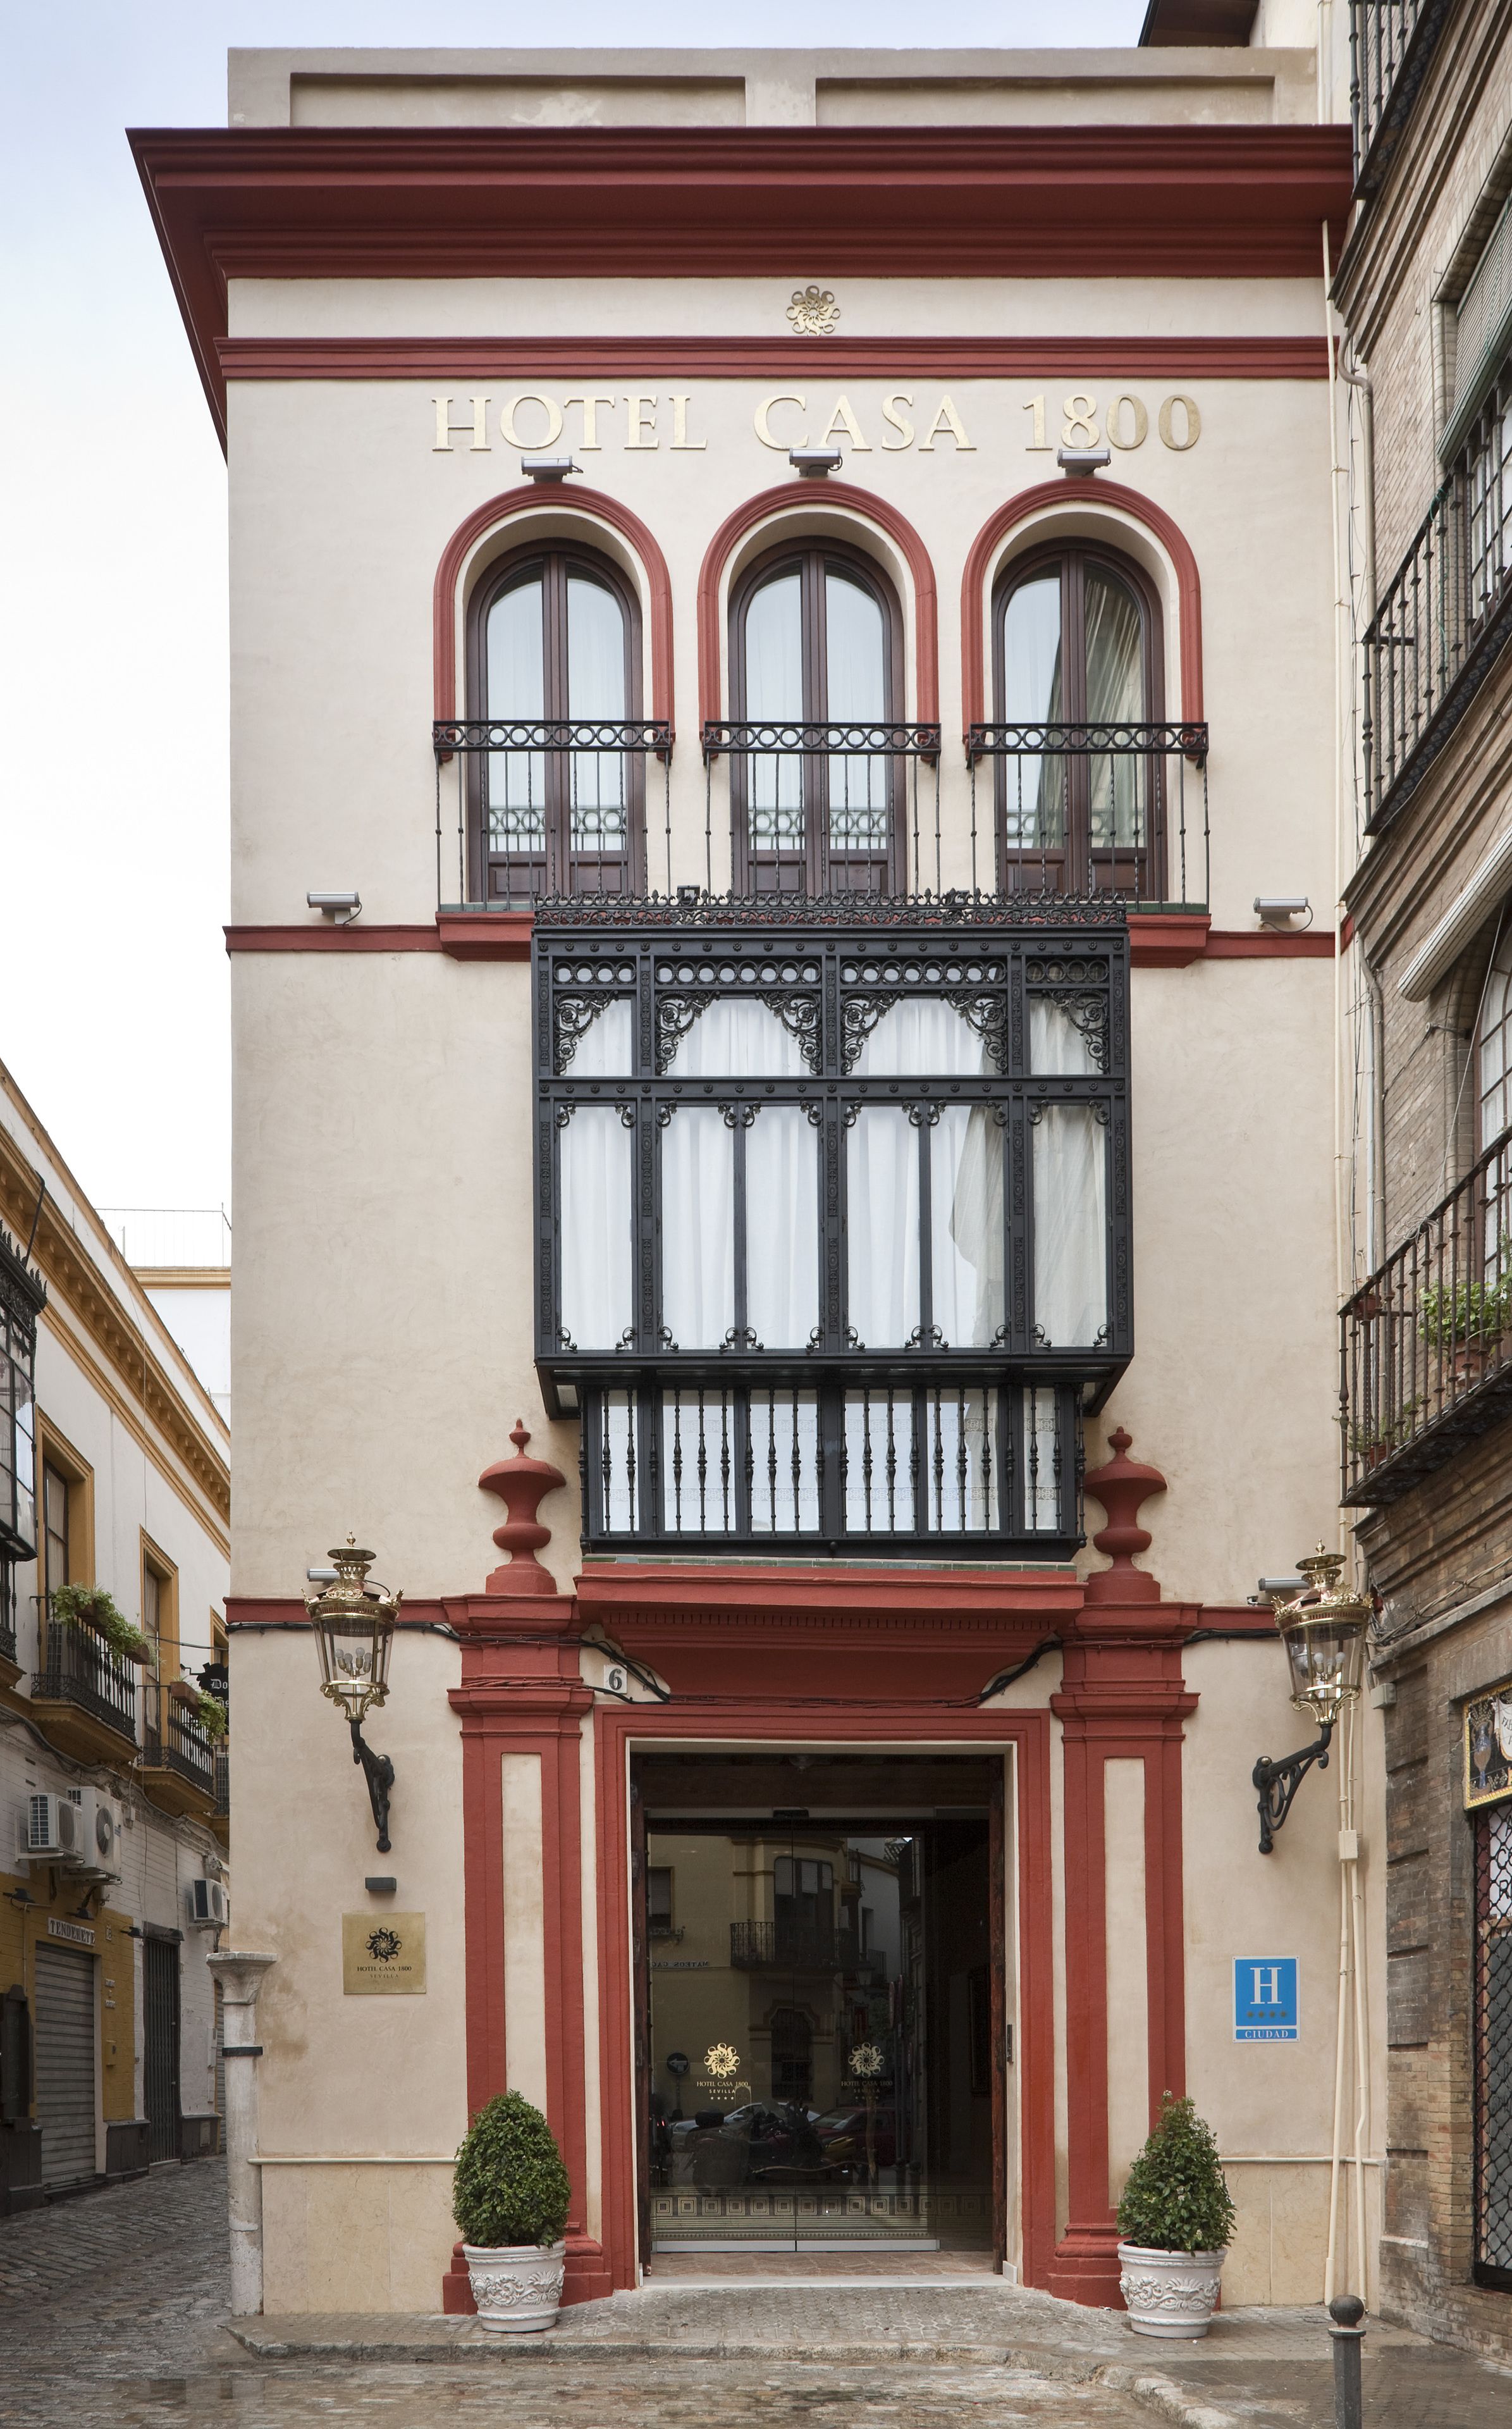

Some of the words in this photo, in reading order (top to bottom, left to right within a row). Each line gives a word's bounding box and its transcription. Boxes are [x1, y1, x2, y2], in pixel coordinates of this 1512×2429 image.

[432, 394, 707, 451] HOTEL
[753, 394, 977, 451] CASA
[1023, 394, 1201, 451] 1800
[608, 1669, 622, 1690] 6
[50, 1919, 95, 1944] TENDERETE
[1250, 1967, 1282, 2005] H
[1245, 2030, 1289, 2039] CIUDAD
